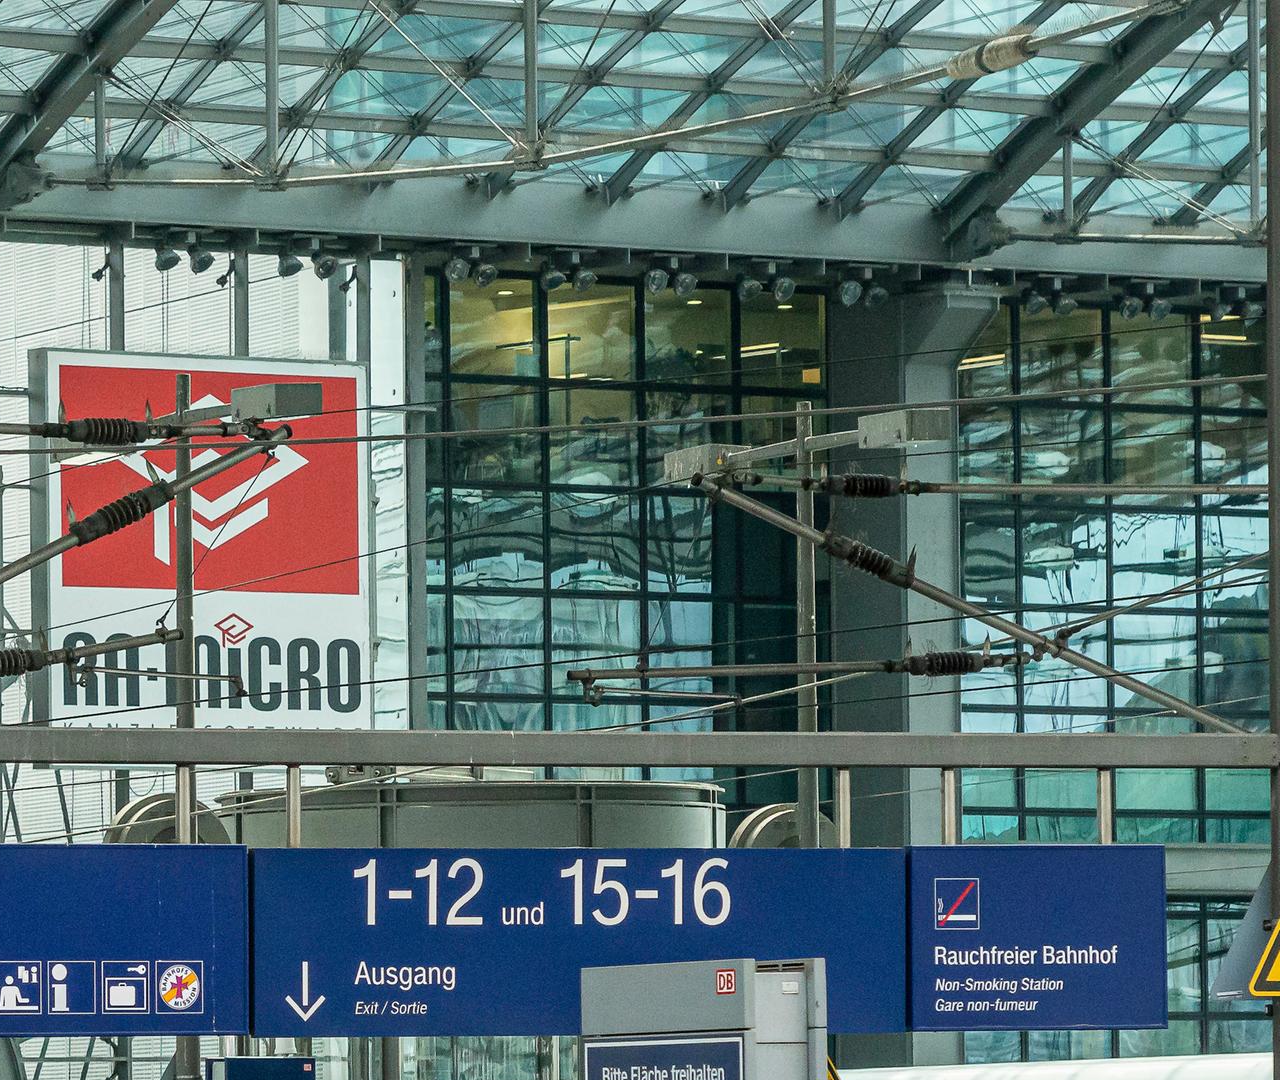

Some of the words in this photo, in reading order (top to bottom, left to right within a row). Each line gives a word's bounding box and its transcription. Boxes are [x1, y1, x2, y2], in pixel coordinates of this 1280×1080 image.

[353, 857, 484, 926] 1-12
[502, 901, 544, 926] und
[560, 857, 732, 927] 15-16
[934, 945, 1038, 966] Rauchfreier
[1042, 945, 1118, 965] Bahnhof
[354, 961, 457, 991] Ausgang
[717, 972, 734, 992] DB
[935, 977, 1018, 994] Non-Smoking
[1020, 977, 1064, 992] Station
[355, 1000, 379, 1015] Exit
[380, 1000, 389, 1015] /
[390, 1000, 428, 1015] Sortie
[935, 998, 964, 1012] Gare
[966, 998, 1039, 1013] non-fumeur
